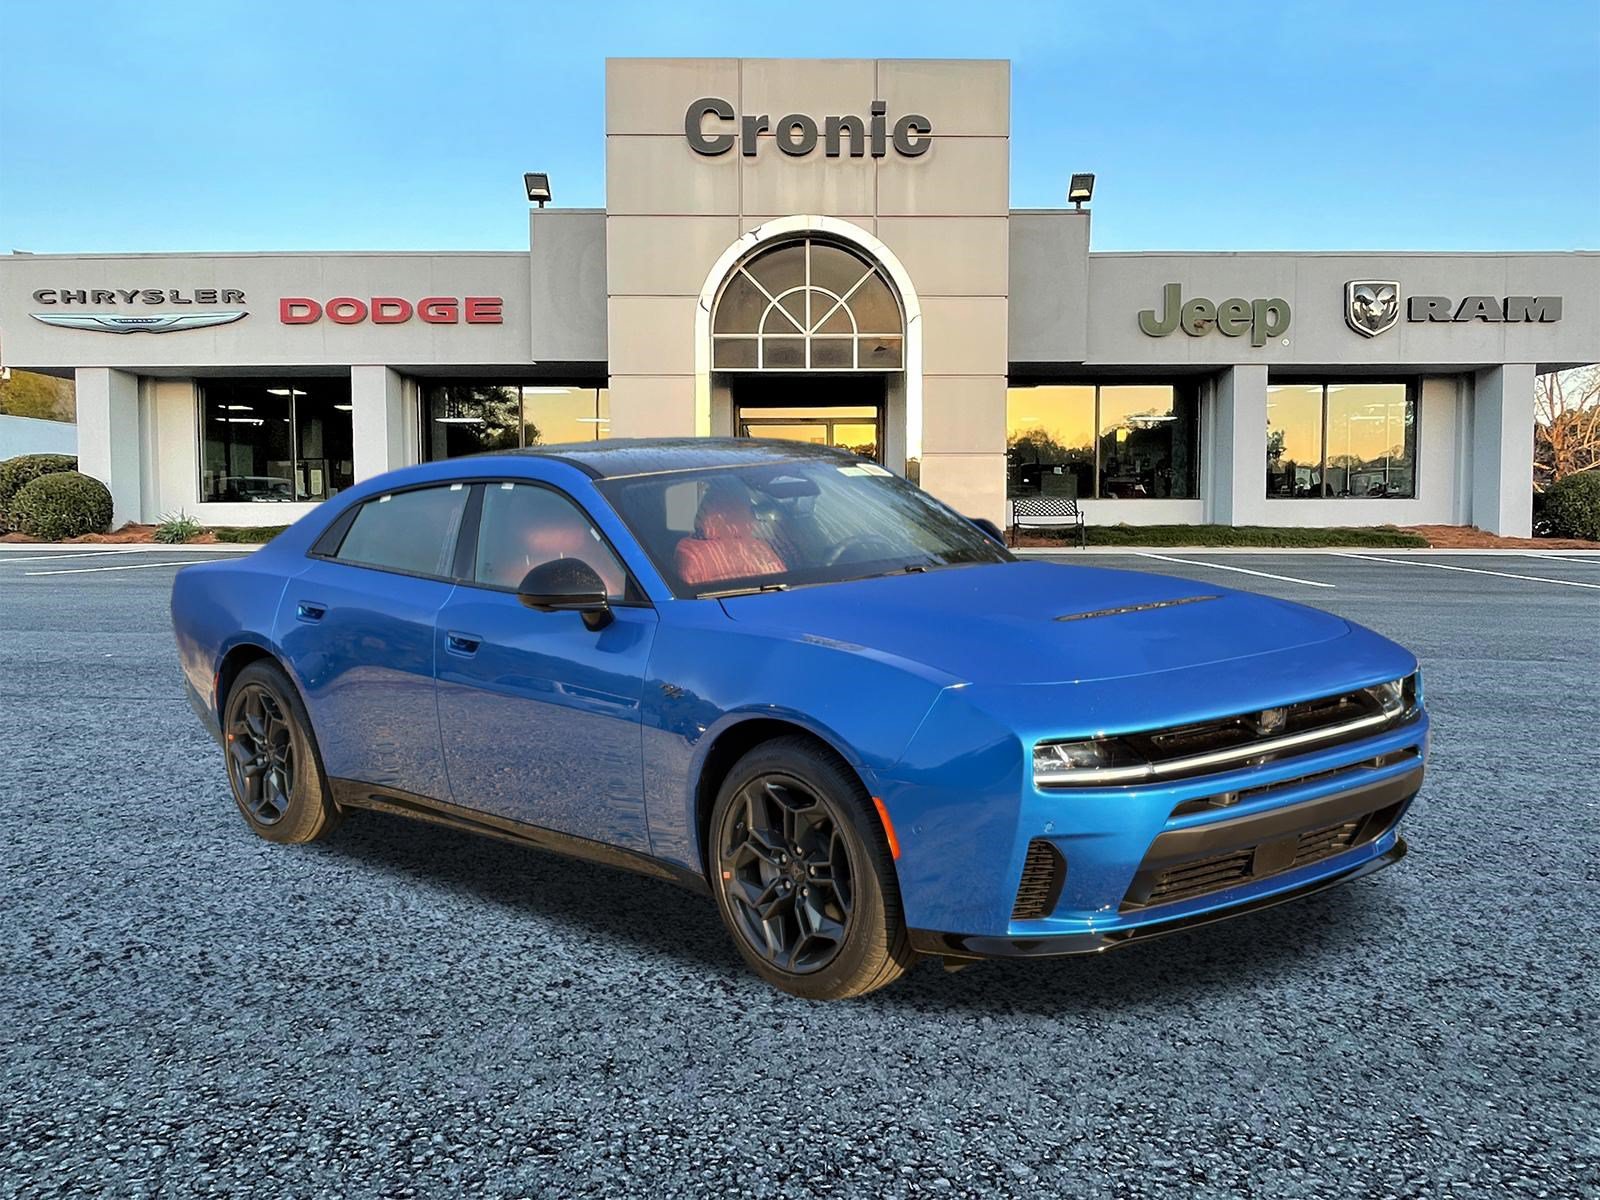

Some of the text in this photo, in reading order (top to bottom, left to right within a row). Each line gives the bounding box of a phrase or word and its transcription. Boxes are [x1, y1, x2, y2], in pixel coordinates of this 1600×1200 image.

[685, 98, 932, 157] Cronic
[33, 289, 247, 305] CHRYSLER
[280, 297, 503, 324] DODGE
[1408, 296, 1563, 323] RAM
[1138, 283, 1291, 347] Jeep
